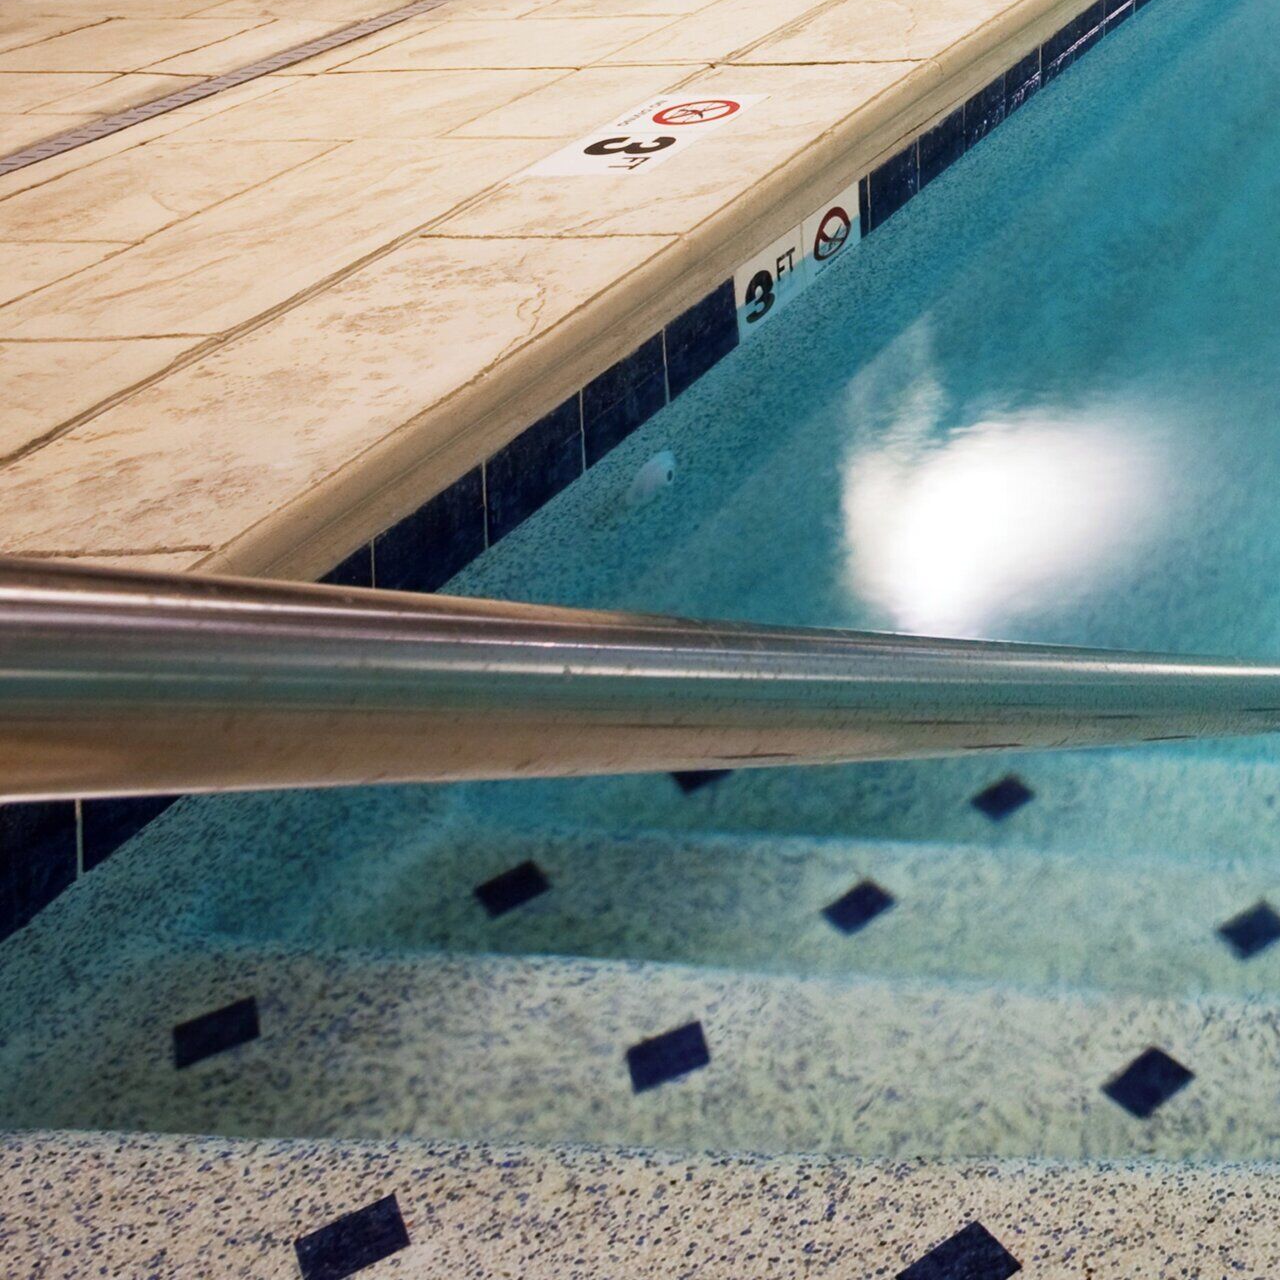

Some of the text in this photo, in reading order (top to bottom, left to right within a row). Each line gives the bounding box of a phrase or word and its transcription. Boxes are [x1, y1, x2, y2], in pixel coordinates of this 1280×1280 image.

[583, 136, 677, 155] 3
[607, 156, 651, 171] FT
[745, 246, 796, 324] 3 FT
